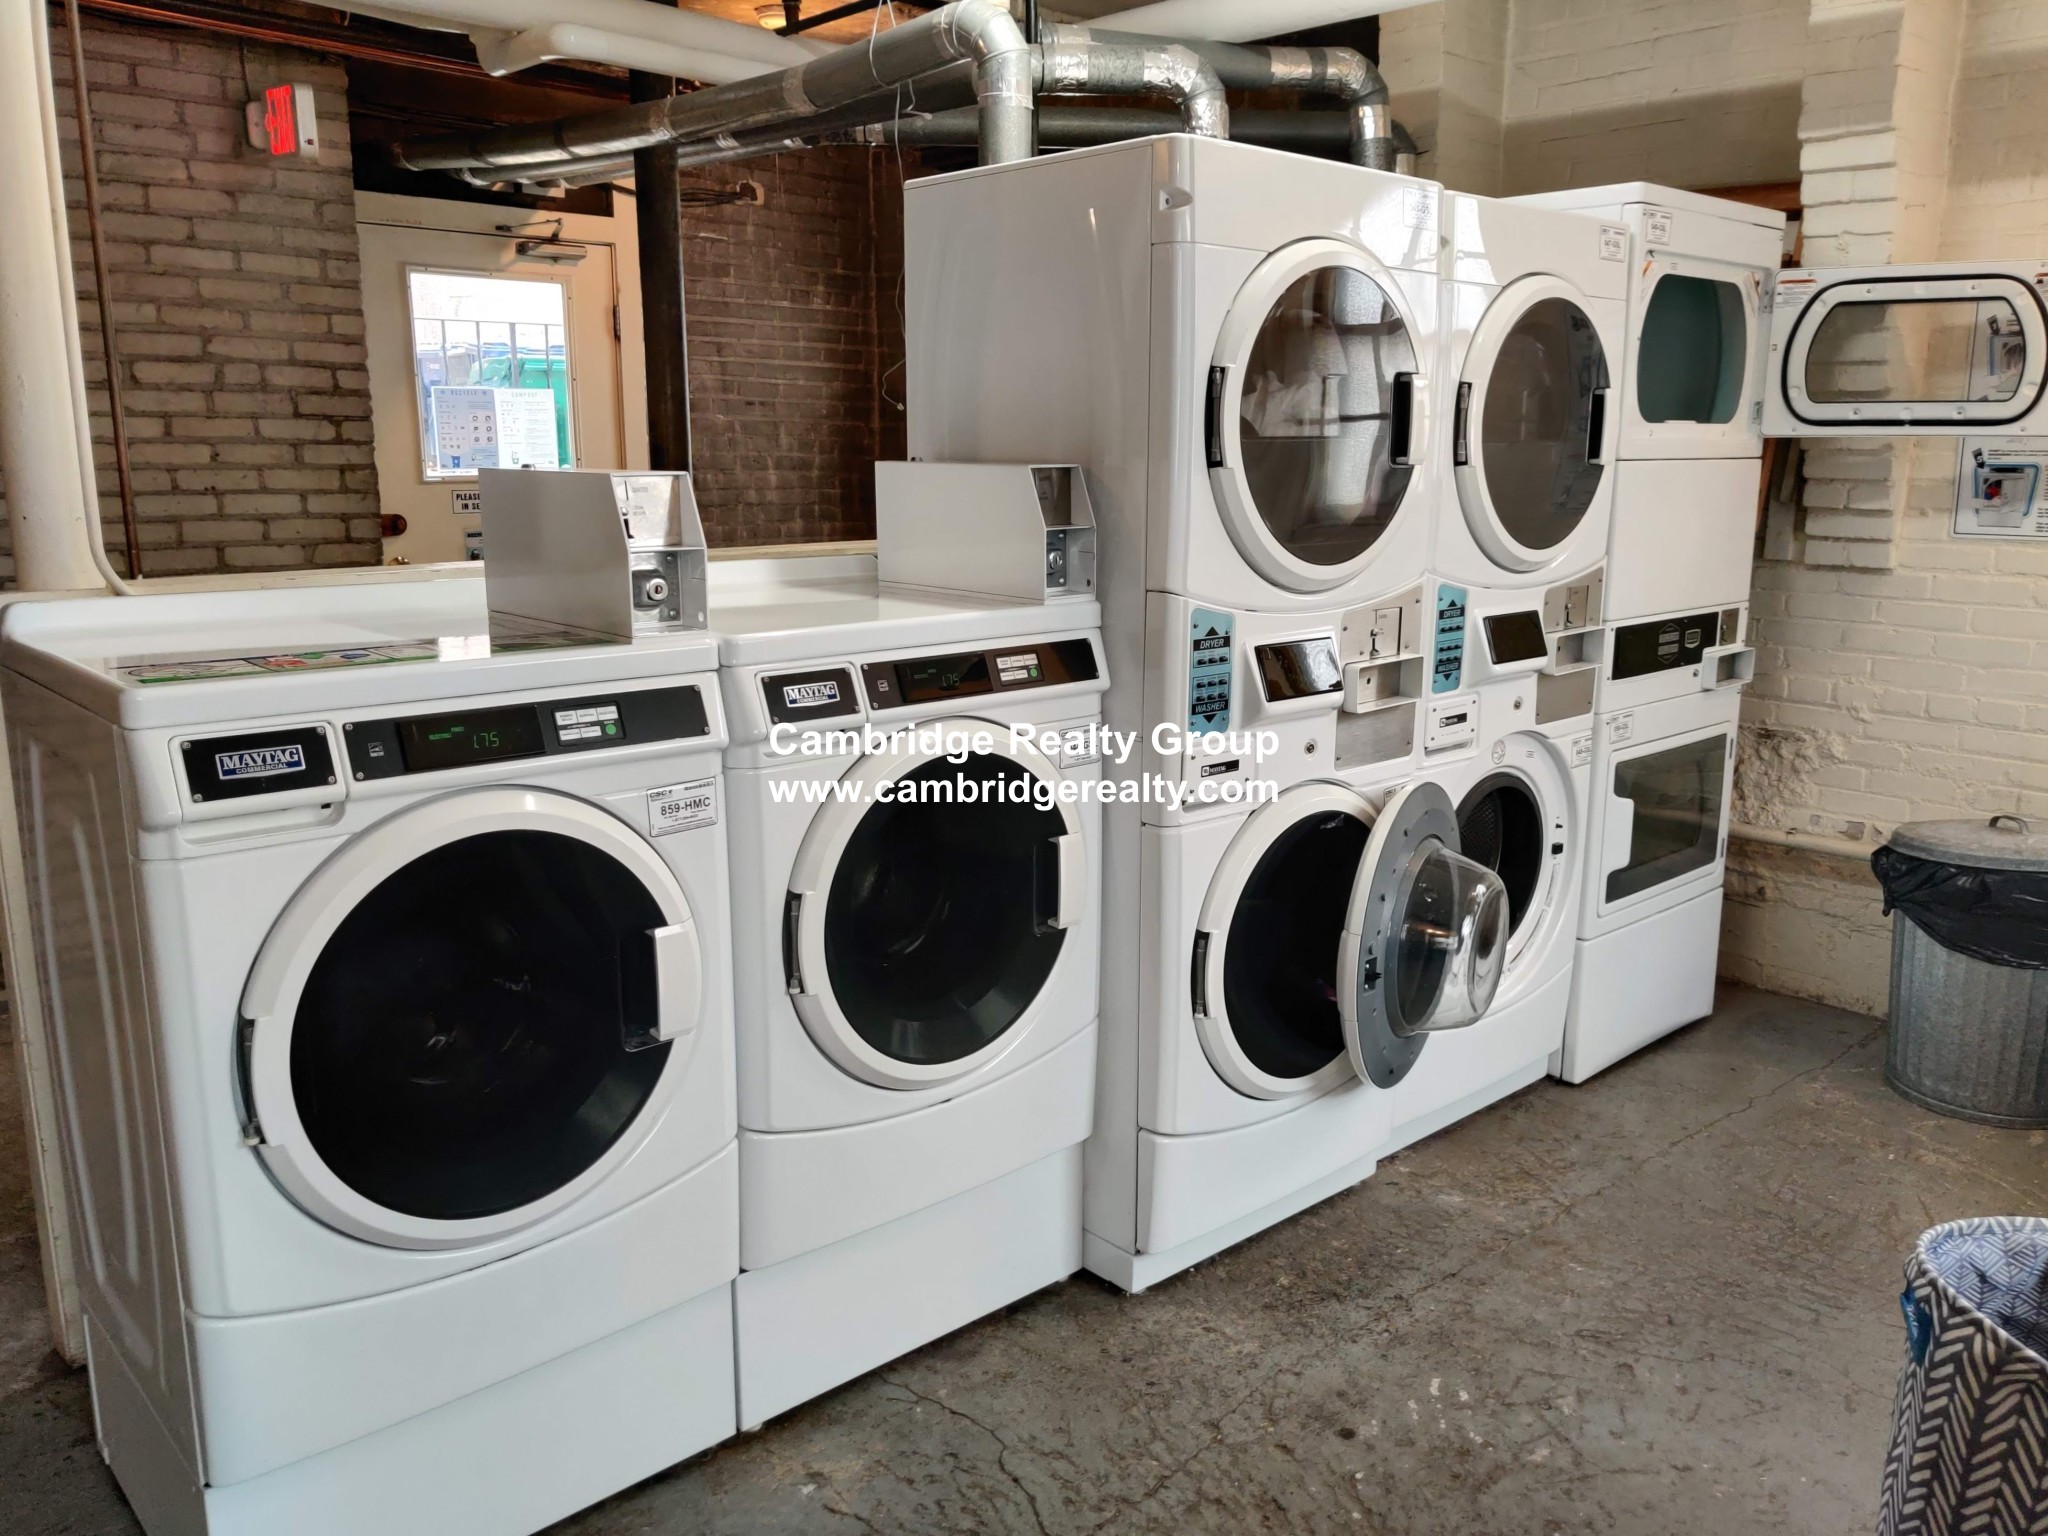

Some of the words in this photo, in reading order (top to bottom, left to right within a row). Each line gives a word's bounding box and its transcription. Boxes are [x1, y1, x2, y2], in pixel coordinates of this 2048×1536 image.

[462, 503, 469, 511] IN
[472, 502, 481, 510] SE
[1200, 638, 1225, 649] DRYER
[787, 684, 835, 700] MAYTAG
[1195, 701, 1226, 713] WASHER
[220, 748, 299, 771] MAYTAG
[236, 763, 289, 775] COMMERCIAL
[649, 789, 668, 799] CSC
[660, 796, 711, 816] 859-HMC
